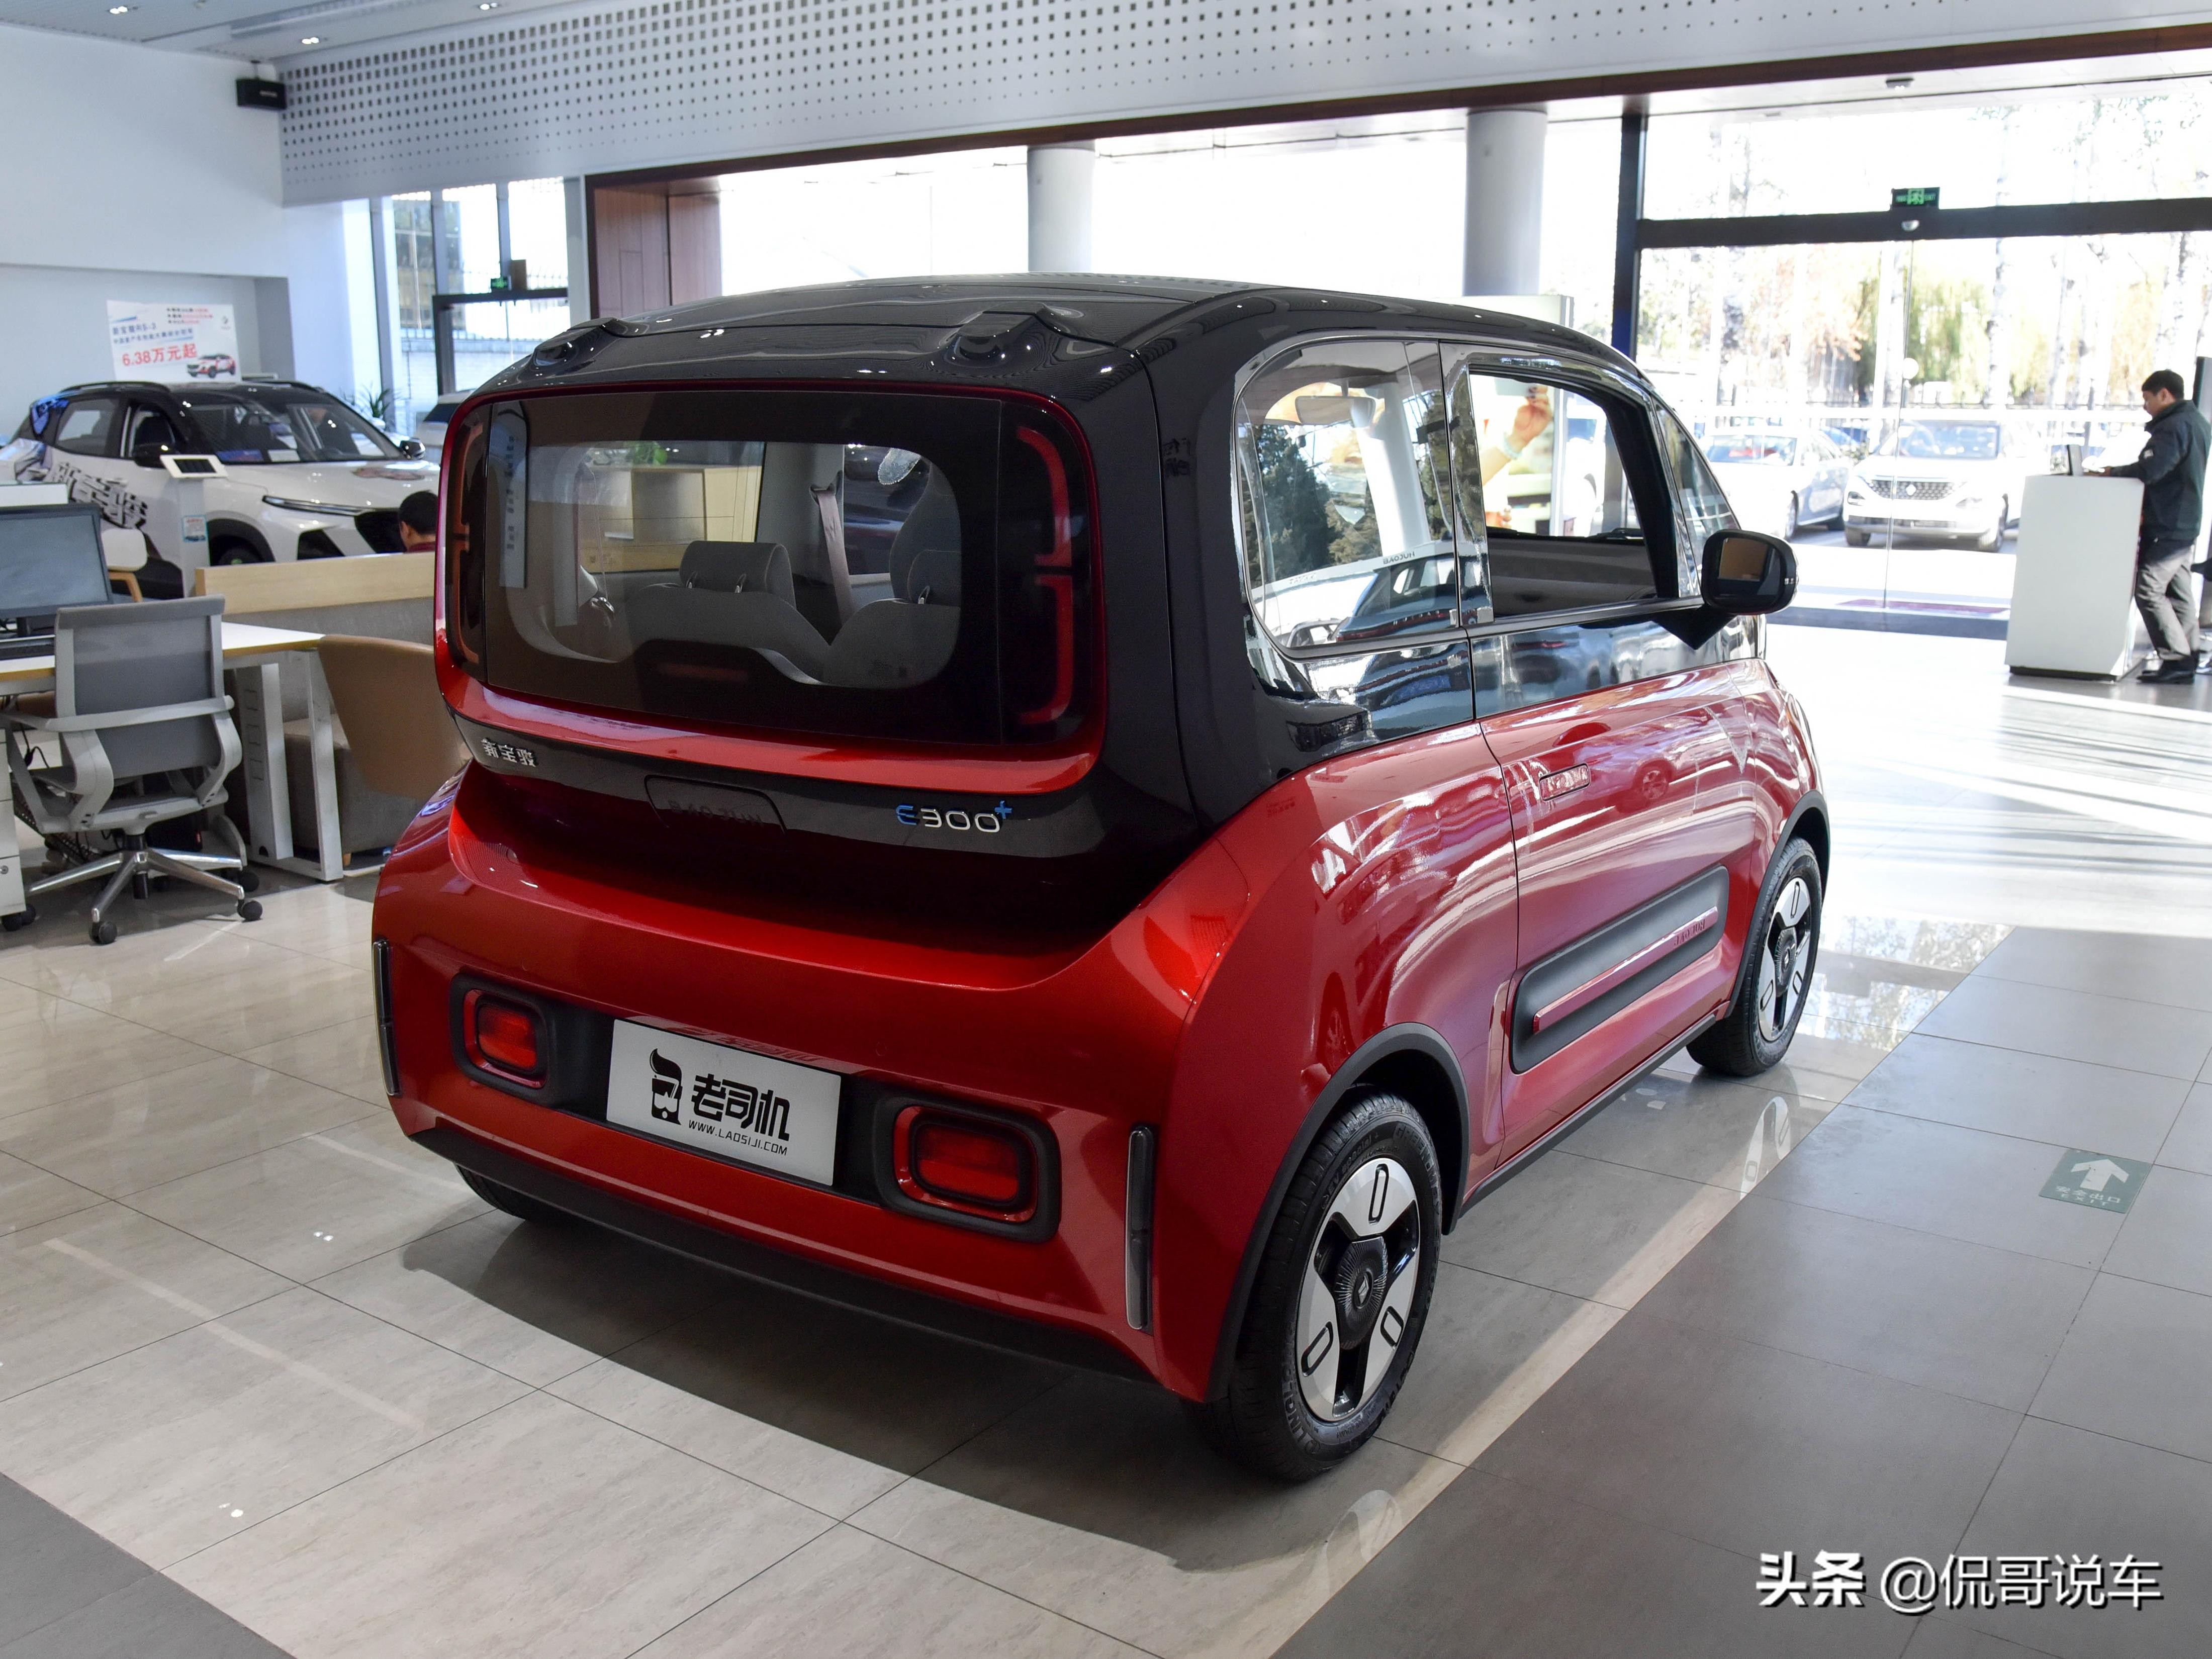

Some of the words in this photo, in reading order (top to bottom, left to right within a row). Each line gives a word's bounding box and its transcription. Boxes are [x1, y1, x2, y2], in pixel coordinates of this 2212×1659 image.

[122, 343, 198, 366] 6.38万元起
[481, 738, 536, 768] 新宝骏
[691, 1073, 790, 1141] 老司机
[689, 1119, 787, 1156] WWW.LAOSIJI.COM
